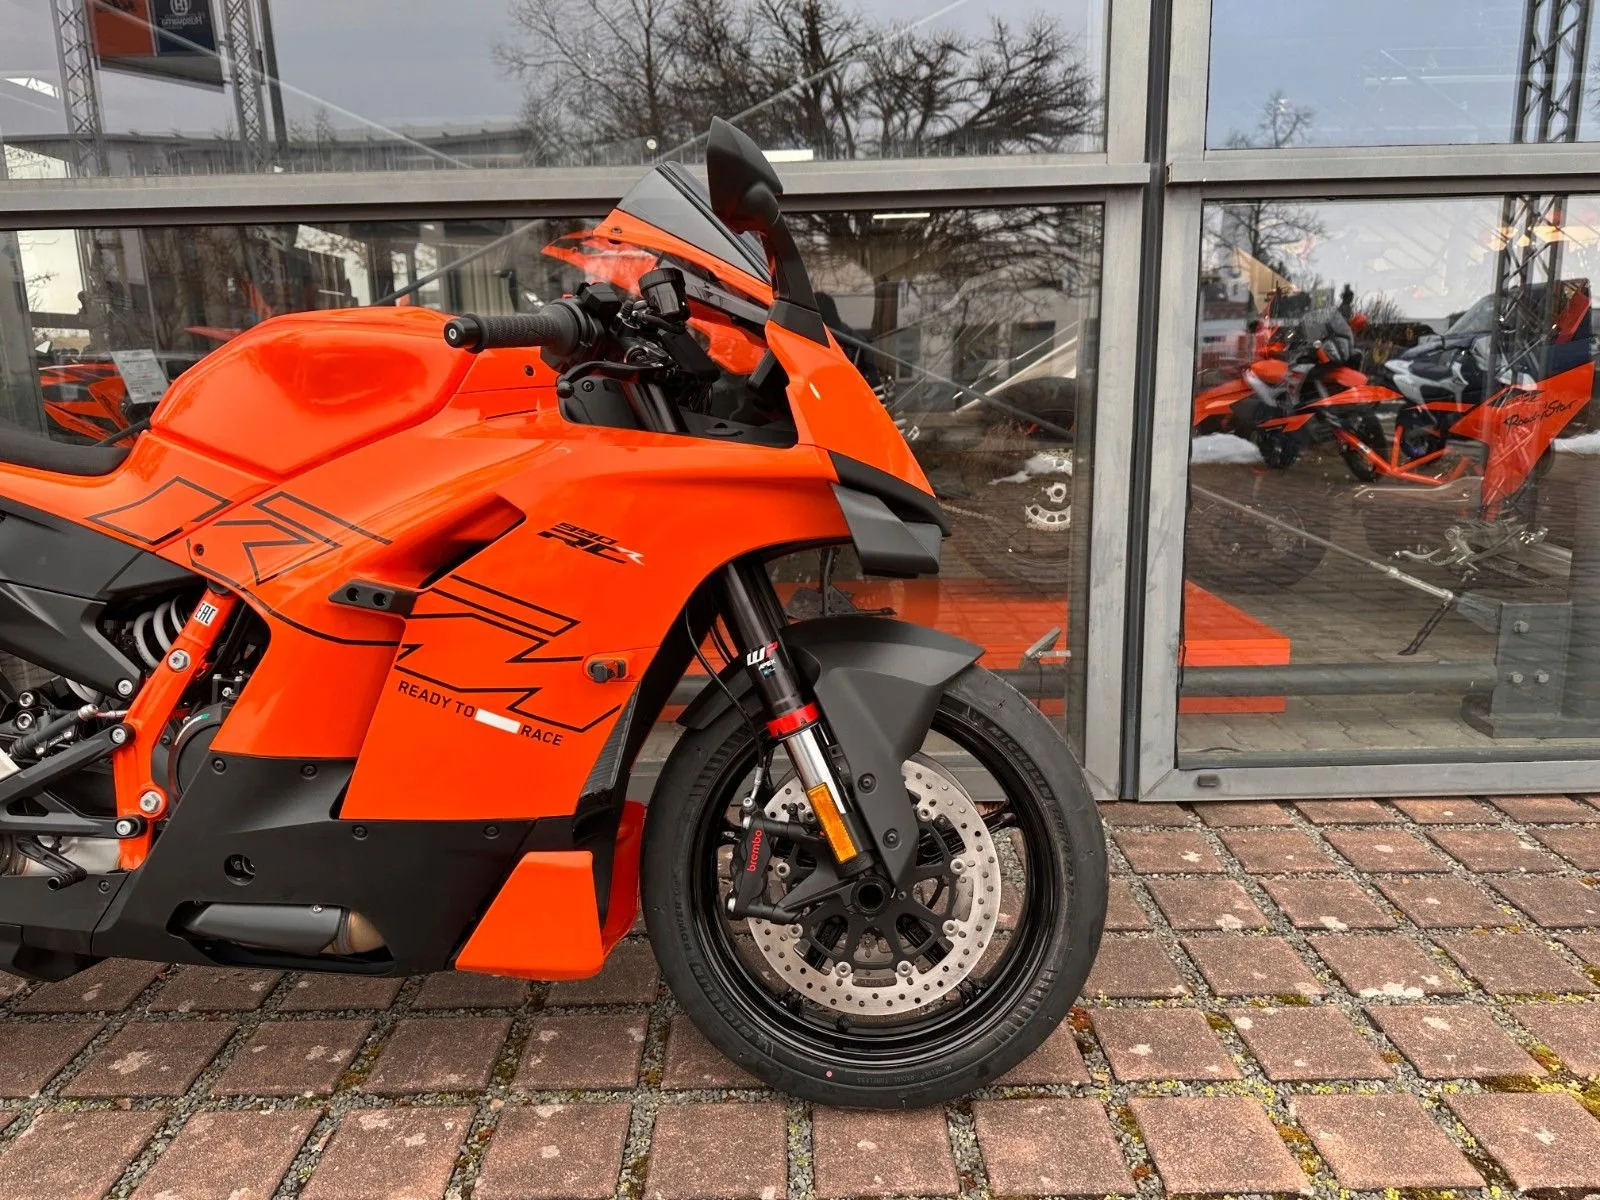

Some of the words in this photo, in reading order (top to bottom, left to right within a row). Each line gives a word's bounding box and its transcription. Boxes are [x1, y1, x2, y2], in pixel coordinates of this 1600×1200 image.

[746, 641, 778, 667] WP
[398, 680, 451, 709] READY
[455, 700, 475, 718] TO
[520, 724, 563, 746] RACE
[747, 829, 762, 871] brembo
[674, 901, 692, 951] POWER
